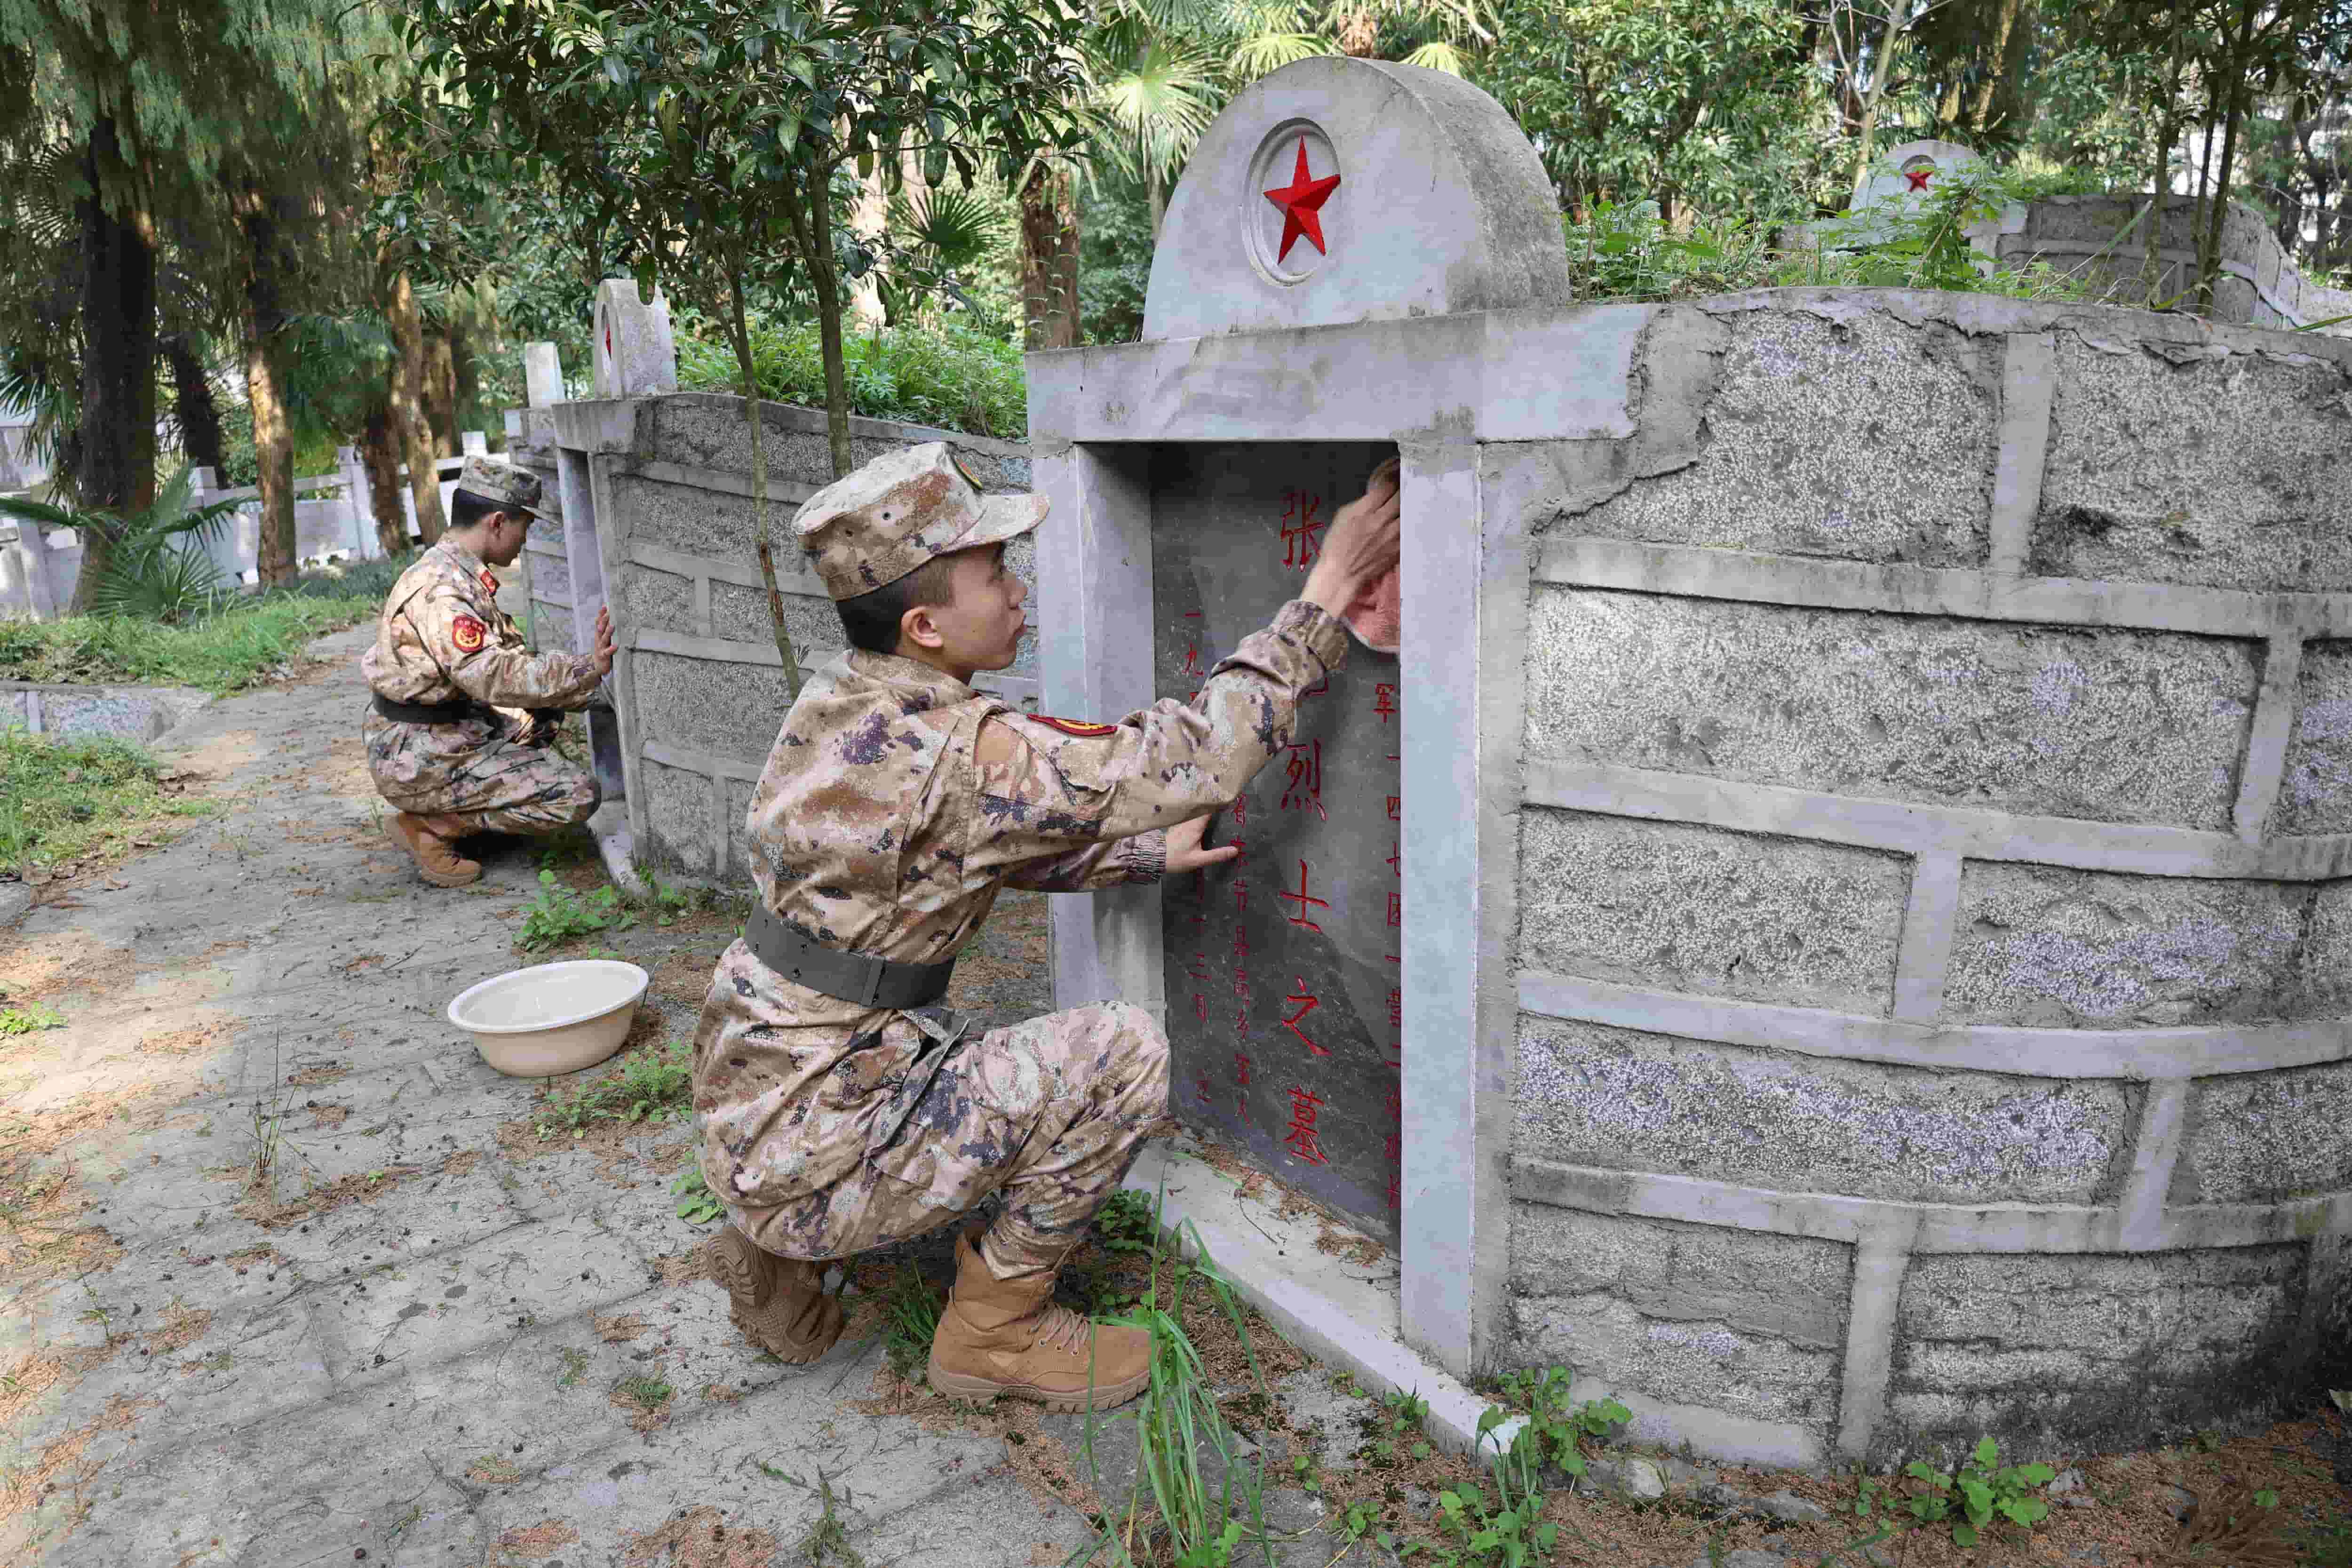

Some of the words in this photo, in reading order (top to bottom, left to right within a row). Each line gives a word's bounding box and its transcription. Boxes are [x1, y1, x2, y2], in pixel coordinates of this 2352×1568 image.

[1279, 487, 1331, 1166] 张烈士之墓
